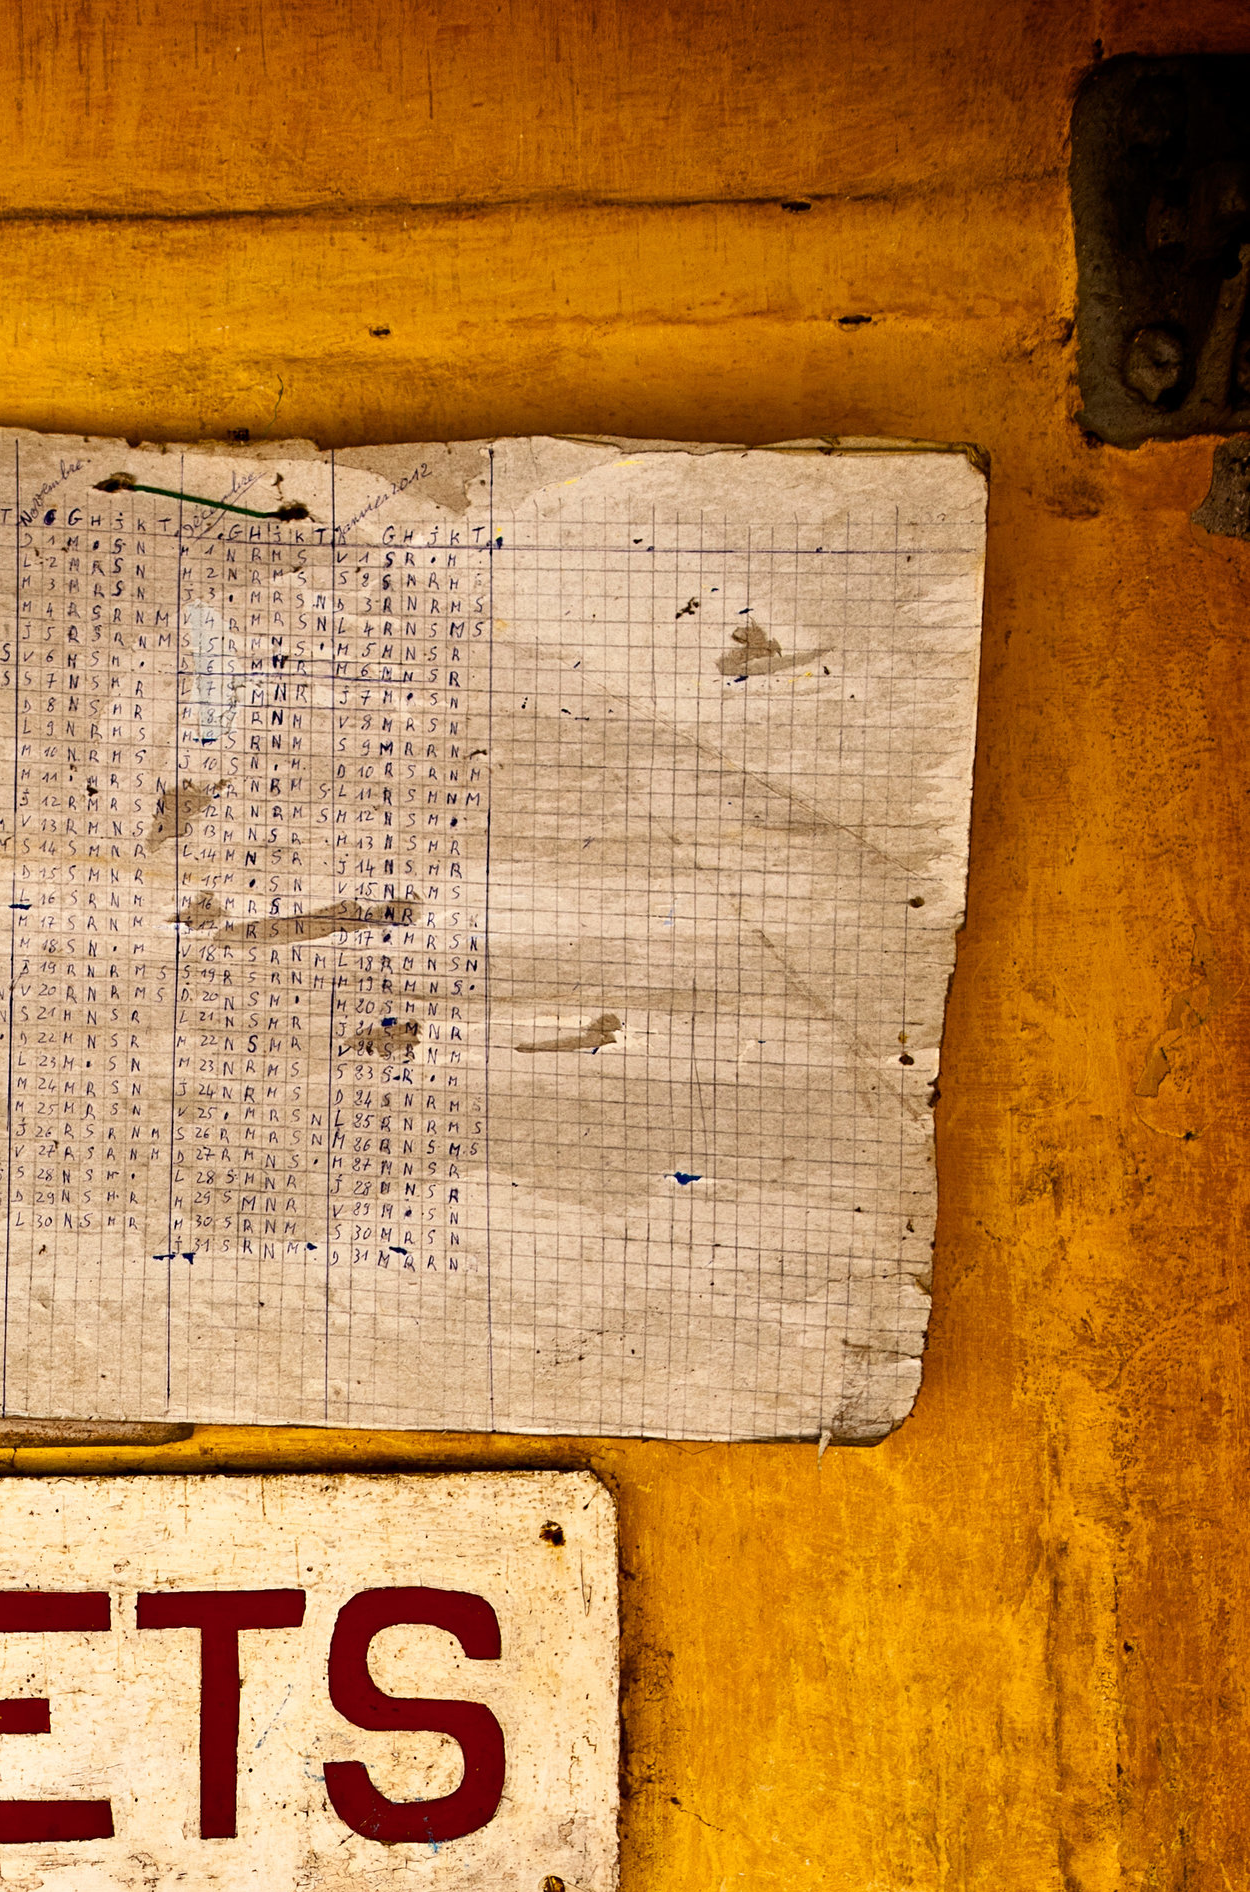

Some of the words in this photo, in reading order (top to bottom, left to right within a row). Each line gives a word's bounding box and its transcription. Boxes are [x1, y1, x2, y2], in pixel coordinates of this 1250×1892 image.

[1, 508, 12, 523] T
[68, 508, 83, 526] G
[91, 516, 101, 526] H
[158, 518, 171, 531] T
[228, 524, 242, 540] G
[250, 526, 261, 540] H
[314, 528, 326, 543] T
[382, 525, 396, 545] G
[403, 530, 414, 543] H
[472, 526, 485, 543] T
[207, 568, 219, 579] 2
[298, 571, 307, 584] S
[46, 603, 55, 620] 4
[92, 605, 102, 622] S
[338, 617, 346, 635] L
[364, 622, 375, 638] 4
[429, 623, 438, 638] S
[473, 622, 485, 638] S
[183, 946, 191, 958] V
[199, 944, 217, 962] 18
[248, 947, 258, 963] S
[21, 1006, 29, 1022] S
[37, 1006, 56, 1021] 21
[111, 1008, 119, 1022] S
[180, 1010, 188, 1024] L
[200, 1012, 214, 1022] 21
[248, 1013, 259, 1029] S
[335, 1110, 345, 1129] L
[472, 1121, 482, 1135] S
[16, 1212, 25, 1227] L
[38, 1215, 53, 1229] 30
[82, 1213, 92, 1227] S
